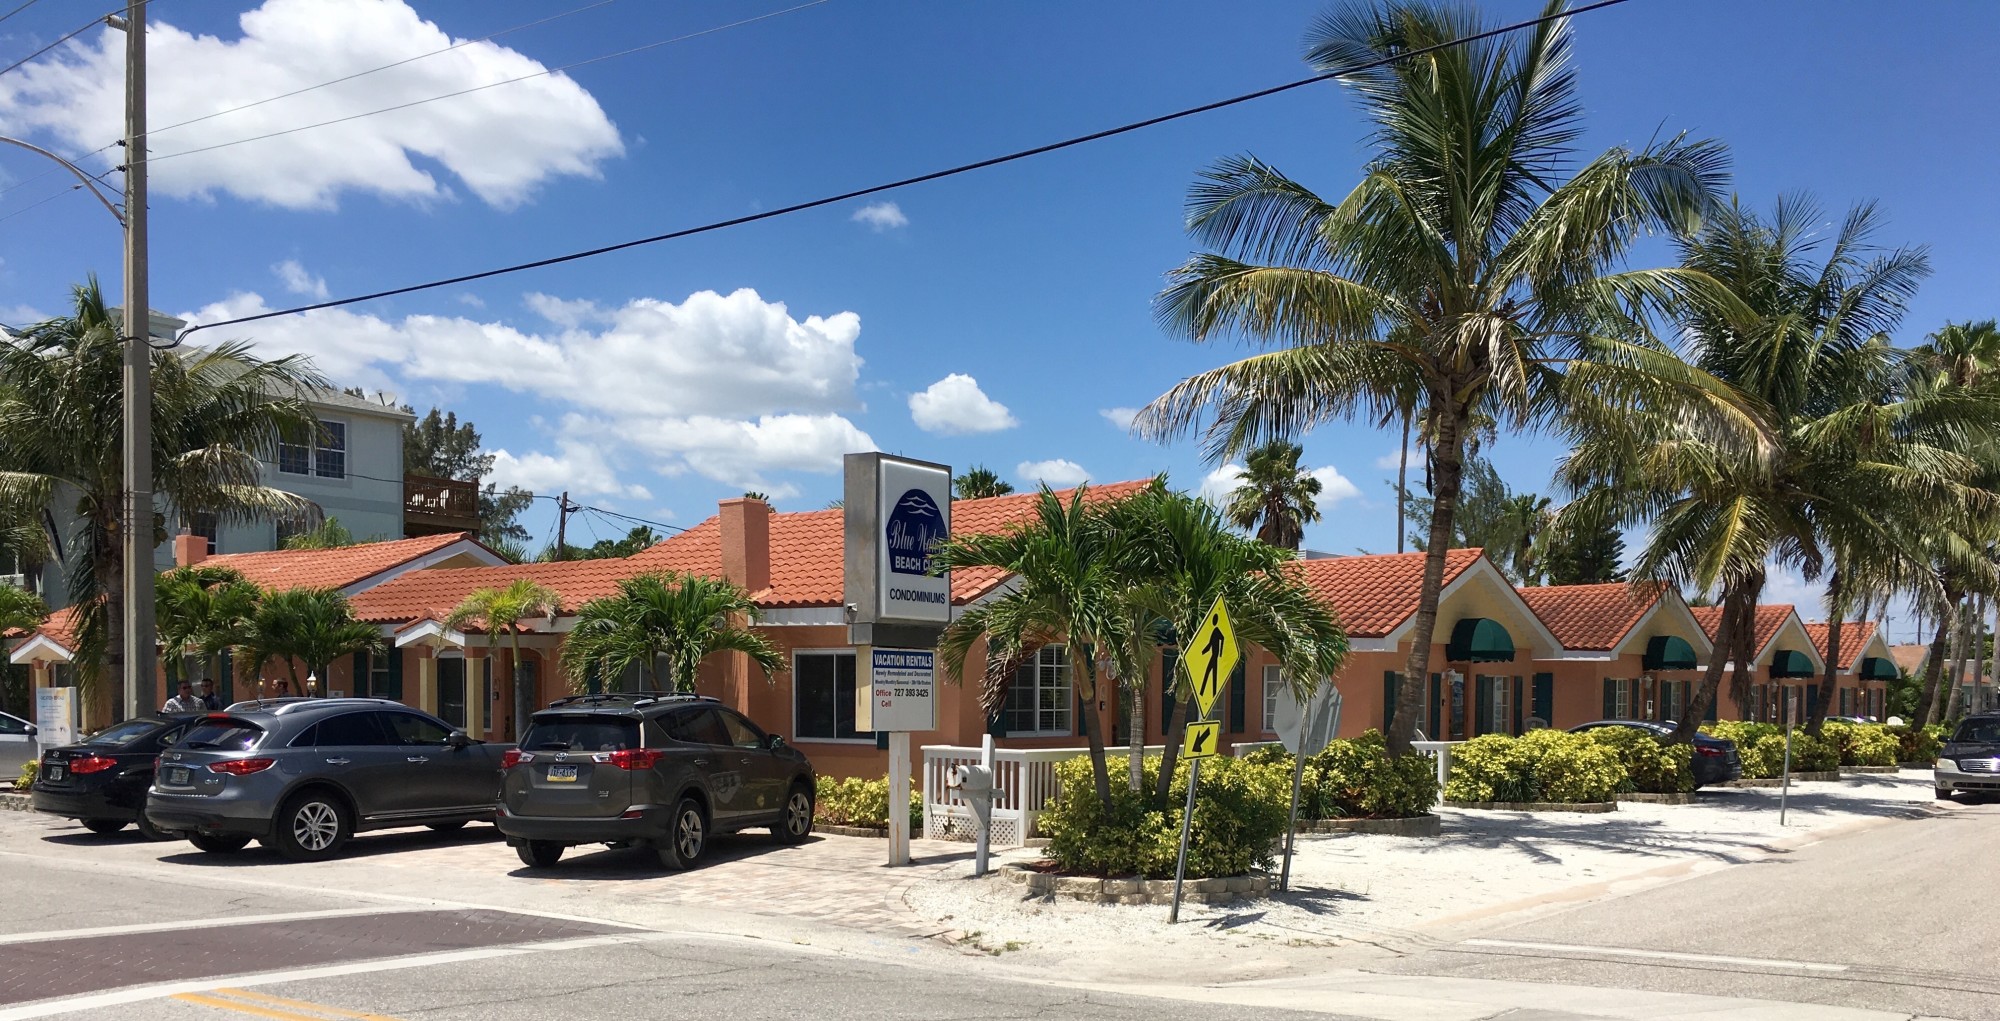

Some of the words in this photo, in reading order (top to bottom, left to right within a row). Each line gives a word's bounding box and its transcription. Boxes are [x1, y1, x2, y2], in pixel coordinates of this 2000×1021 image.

[889, 520, 914, 551] Blue
[895, 556, 920, 571] BEACH
[890, 588, 945, 604] CONDOMINIUMS
[874, 654, 905, 666] VACATION
[906, 655, 933, 667] RENTALS
[875, 689, 891, 697] Office
[894, 689, 904, 697] 727
[916, 689, 929, 697] 3425
